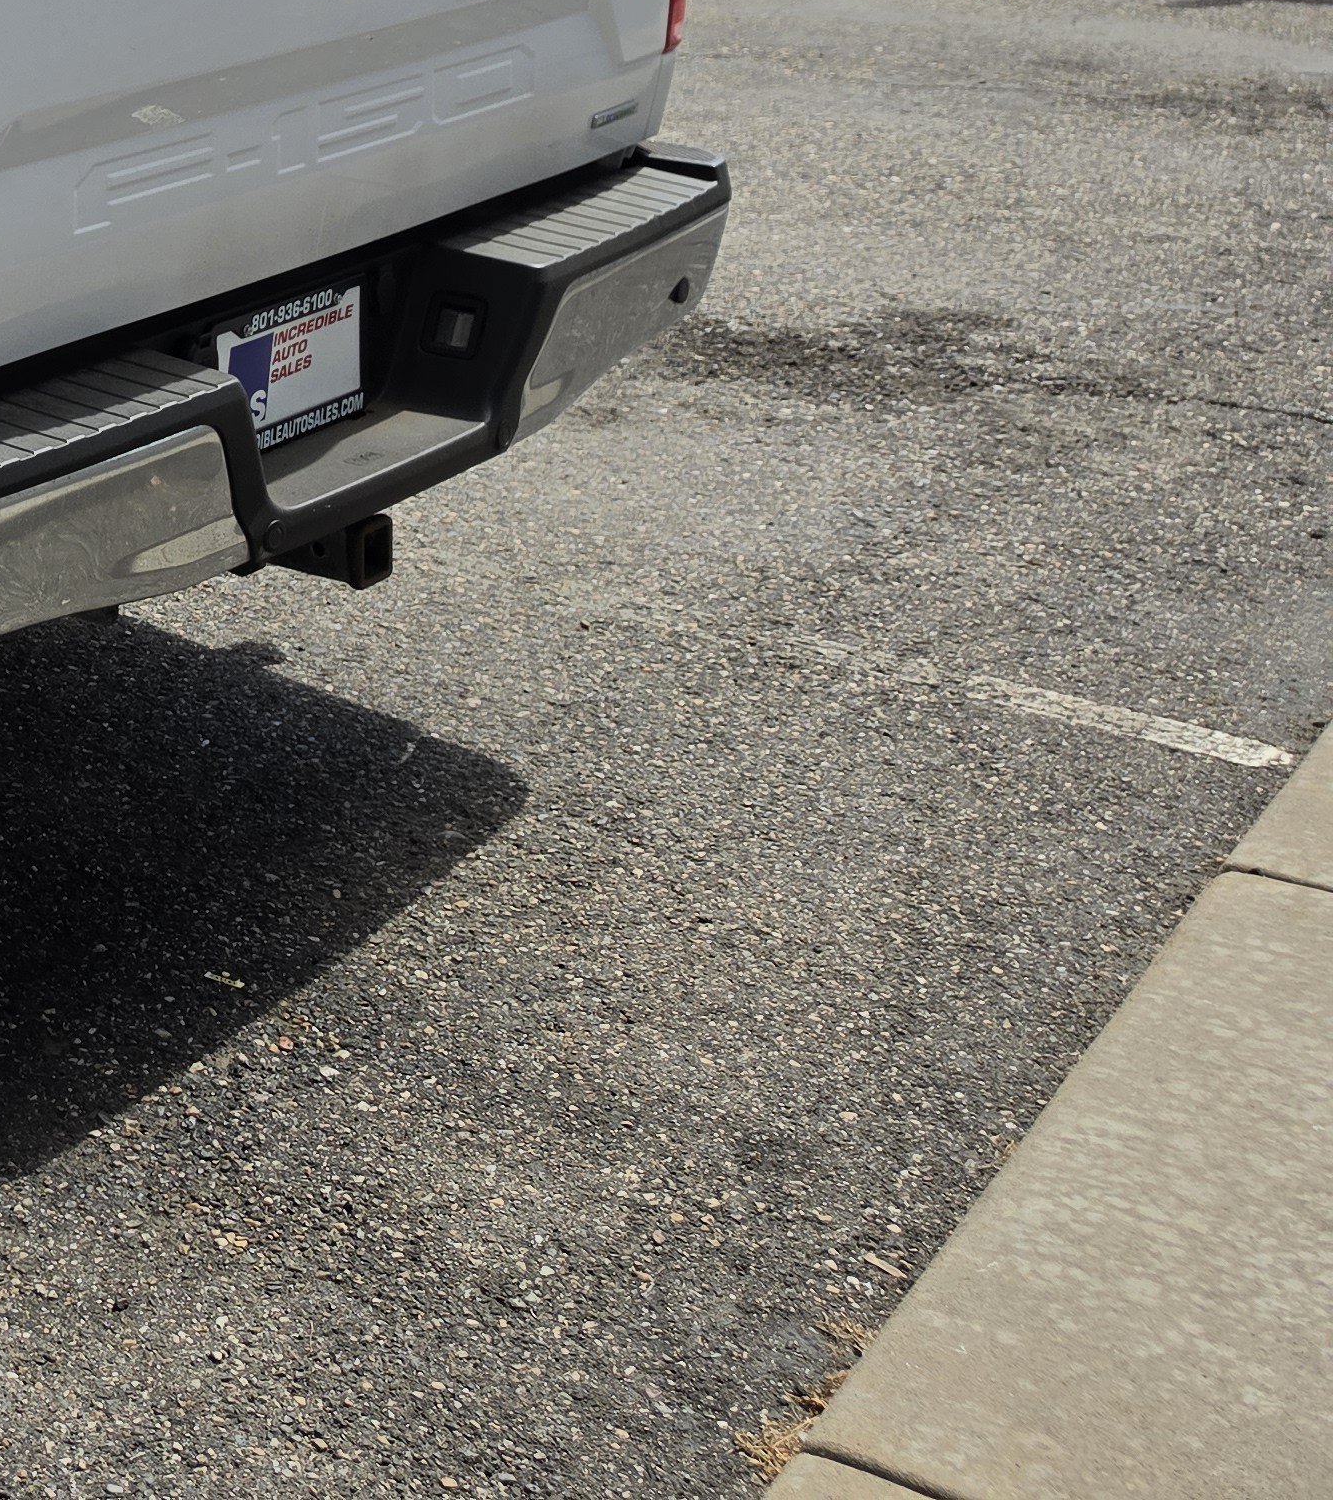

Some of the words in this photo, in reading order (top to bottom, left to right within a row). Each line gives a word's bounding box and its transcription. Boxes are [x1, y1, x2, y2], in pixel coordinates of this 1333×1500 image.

[74, 43, 535, 234] F-150
[251, 288, 333, 331] 801-936-6100
[273, 304, 354, 347] INCREDIBLE
[270, 354, 312, 384] SALES
[271, 338, 308, 365] AUTO
